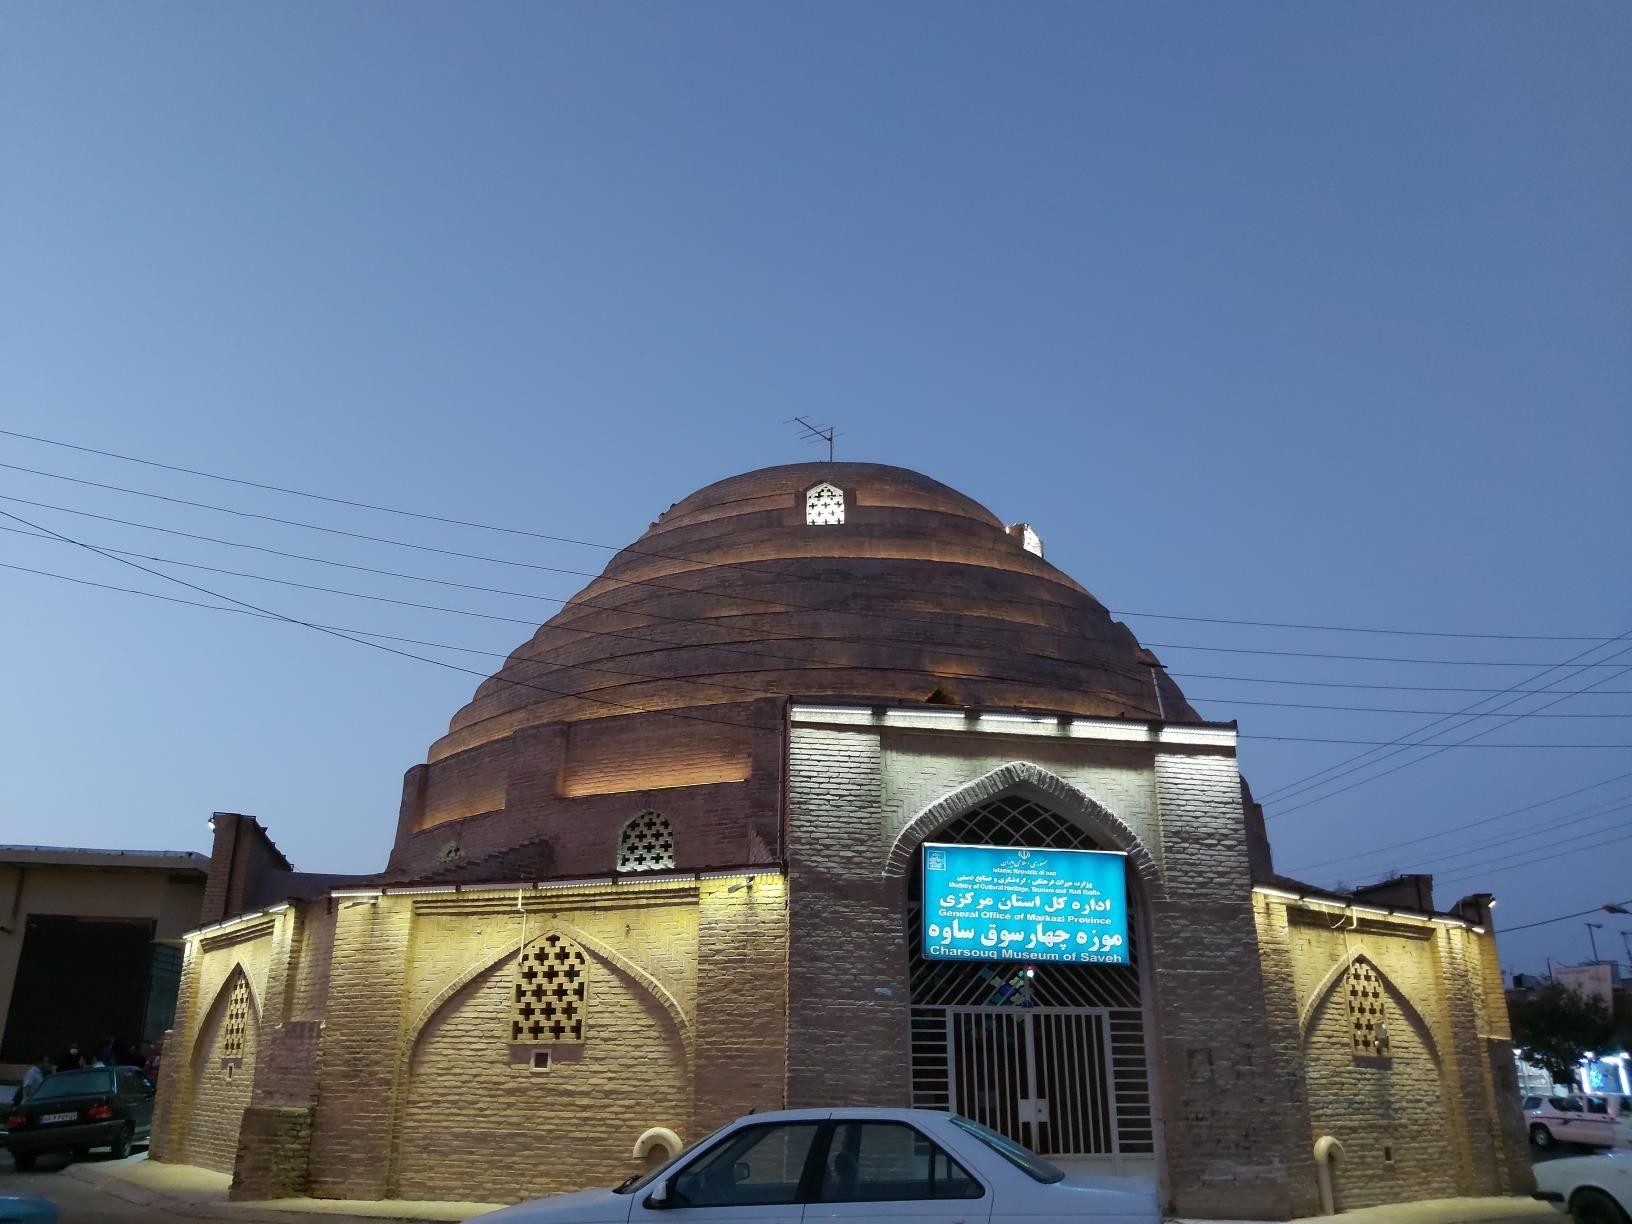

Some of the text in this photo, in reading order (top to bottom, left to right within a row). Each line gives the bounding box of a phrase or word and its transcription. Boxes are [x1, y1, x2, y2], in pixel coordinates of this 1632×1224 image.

[939, 892, 1110, 914] اداره کل استان مرکزی
[939, 909, 978, 918] General
[981, 911, 1011, 920] Office
[1027, 914, 1064, 922] Markazi
[1068, 916, 1112, 925] Province
[928, 919, 974, 945] ساوه
[1076, 929, 1122, 952] موزه
[930, 945, 1121, 963] Charsouq Museum of Saveh
